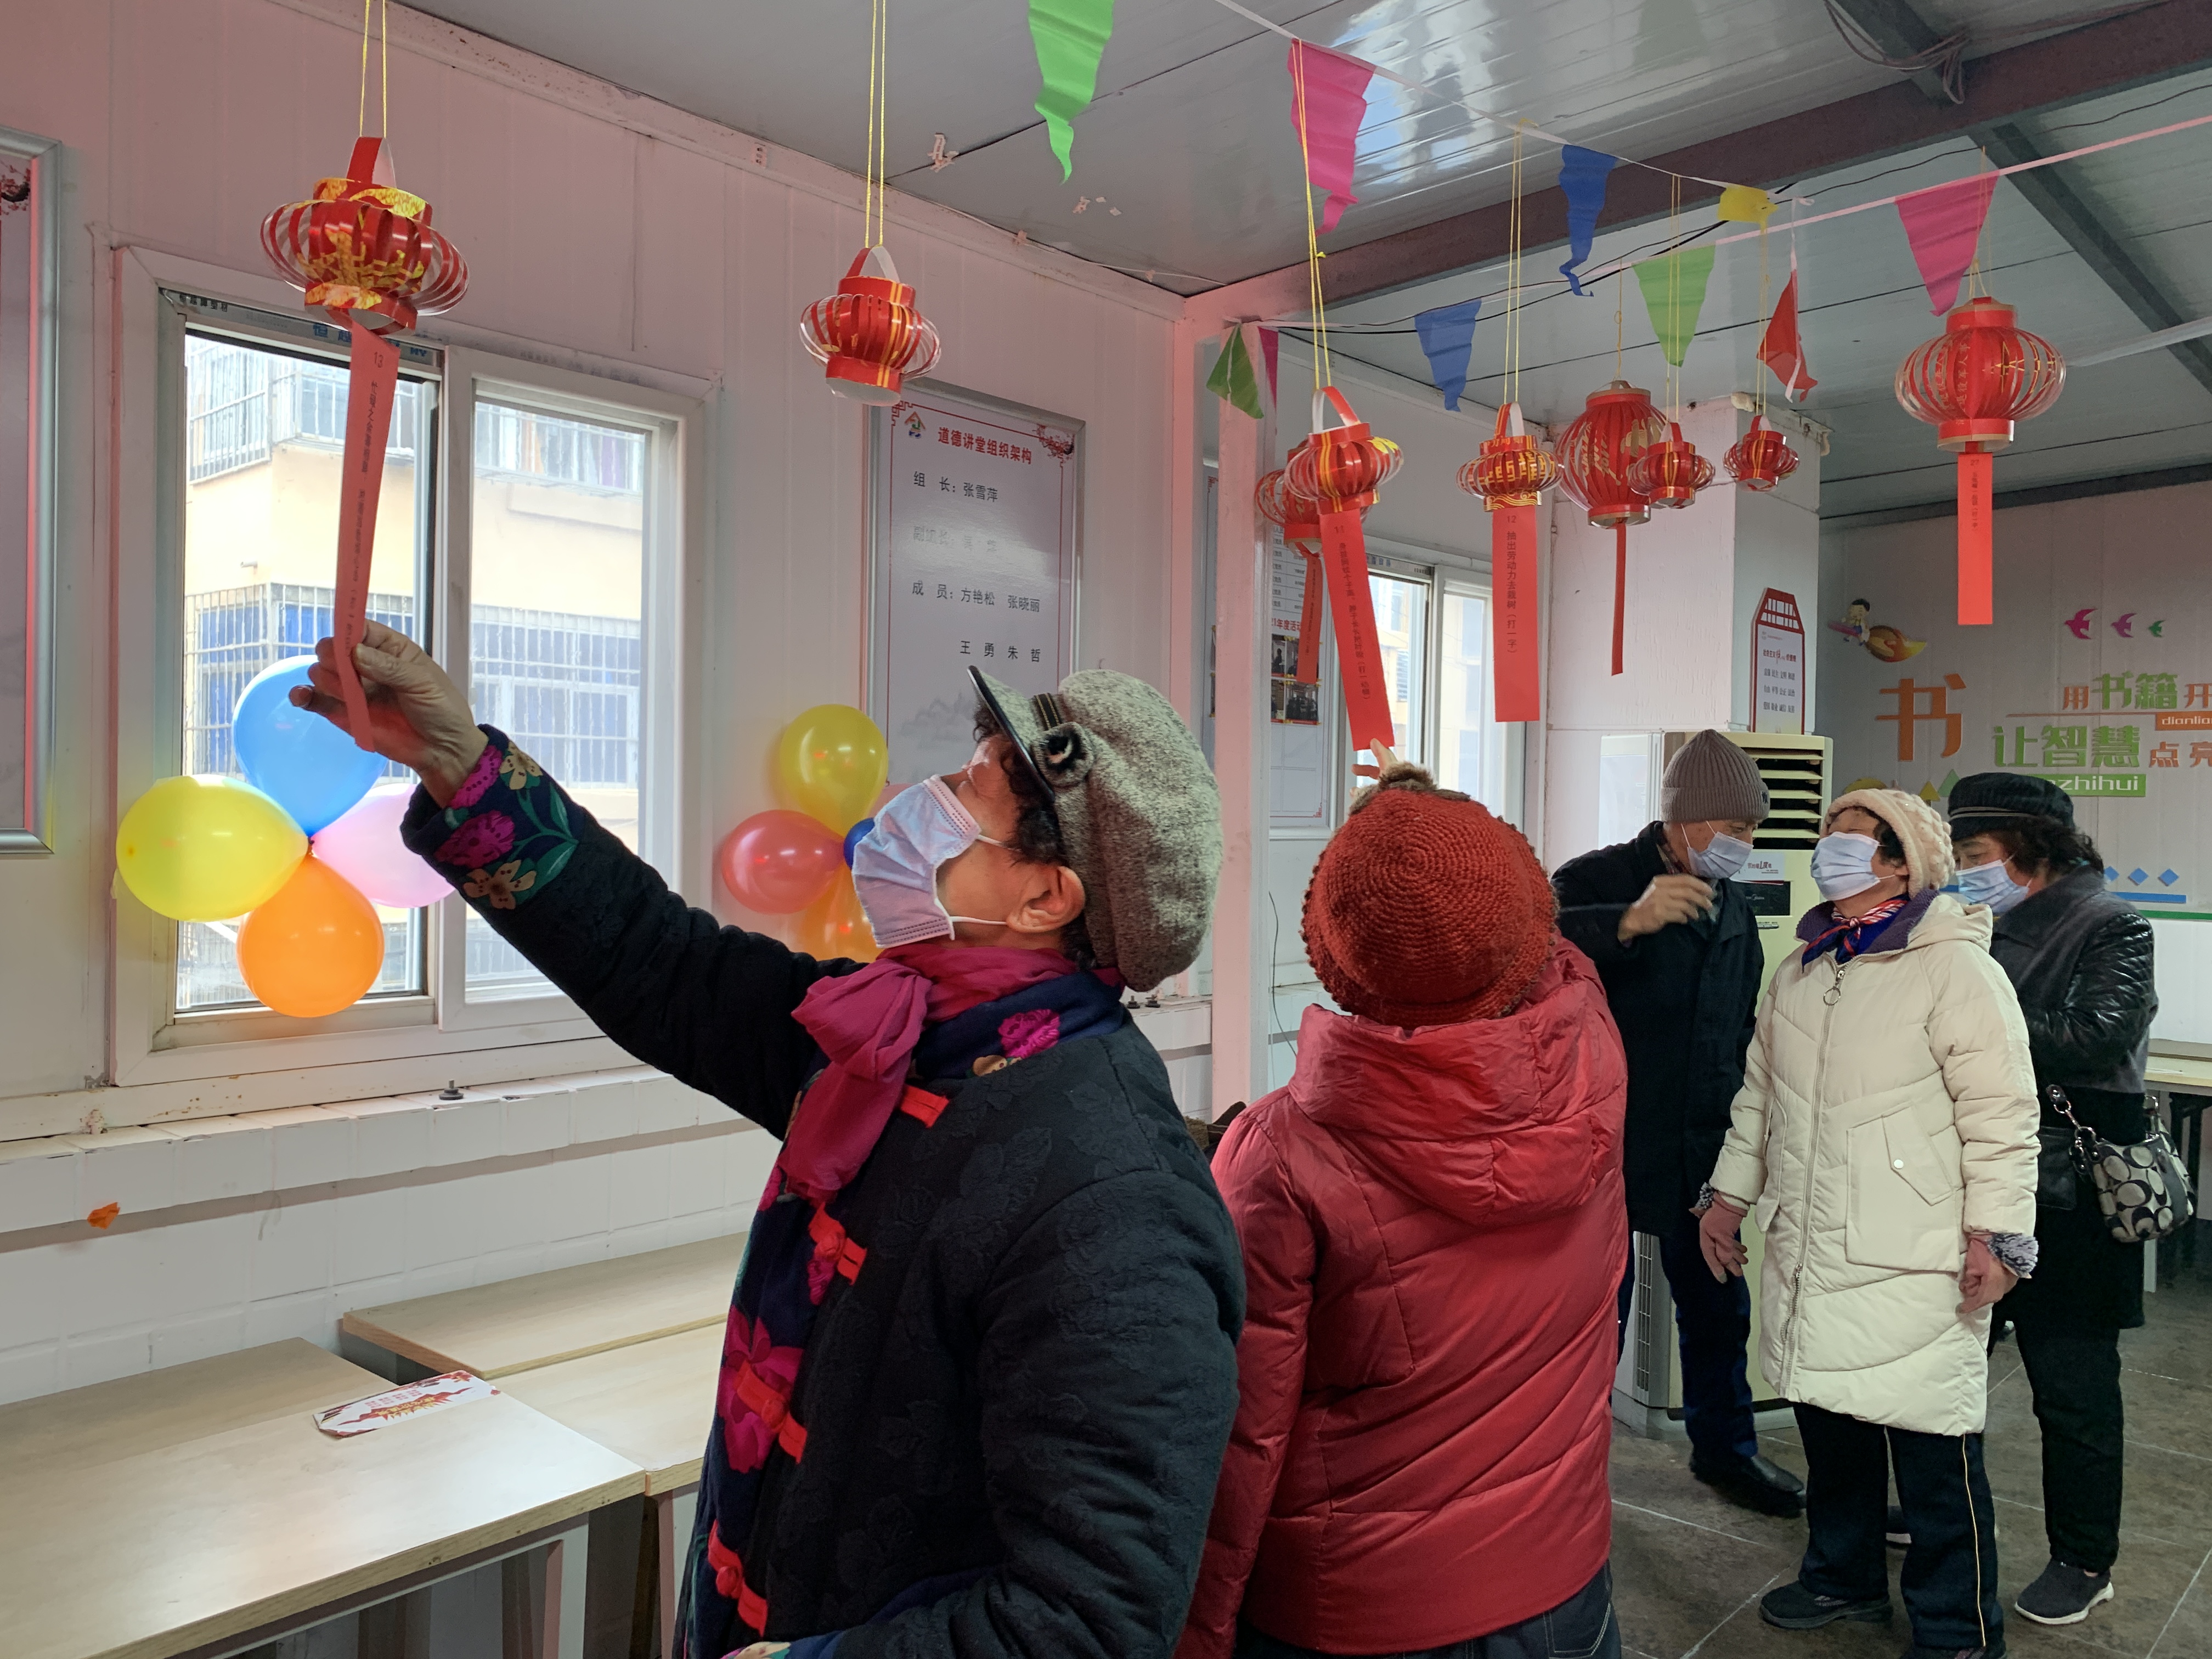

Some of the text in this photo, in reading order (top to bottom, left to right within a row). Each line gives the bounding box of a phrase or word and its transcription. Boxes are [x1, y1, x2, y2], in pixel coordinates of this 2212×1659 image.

[939, 427, 1032, 464] 道德讲堂组织架构
[1875, 673, 1966, 761] 书
[2162, 715, 2212, 725] dianlia
[2048, 775, 2138, 791] zhihui
